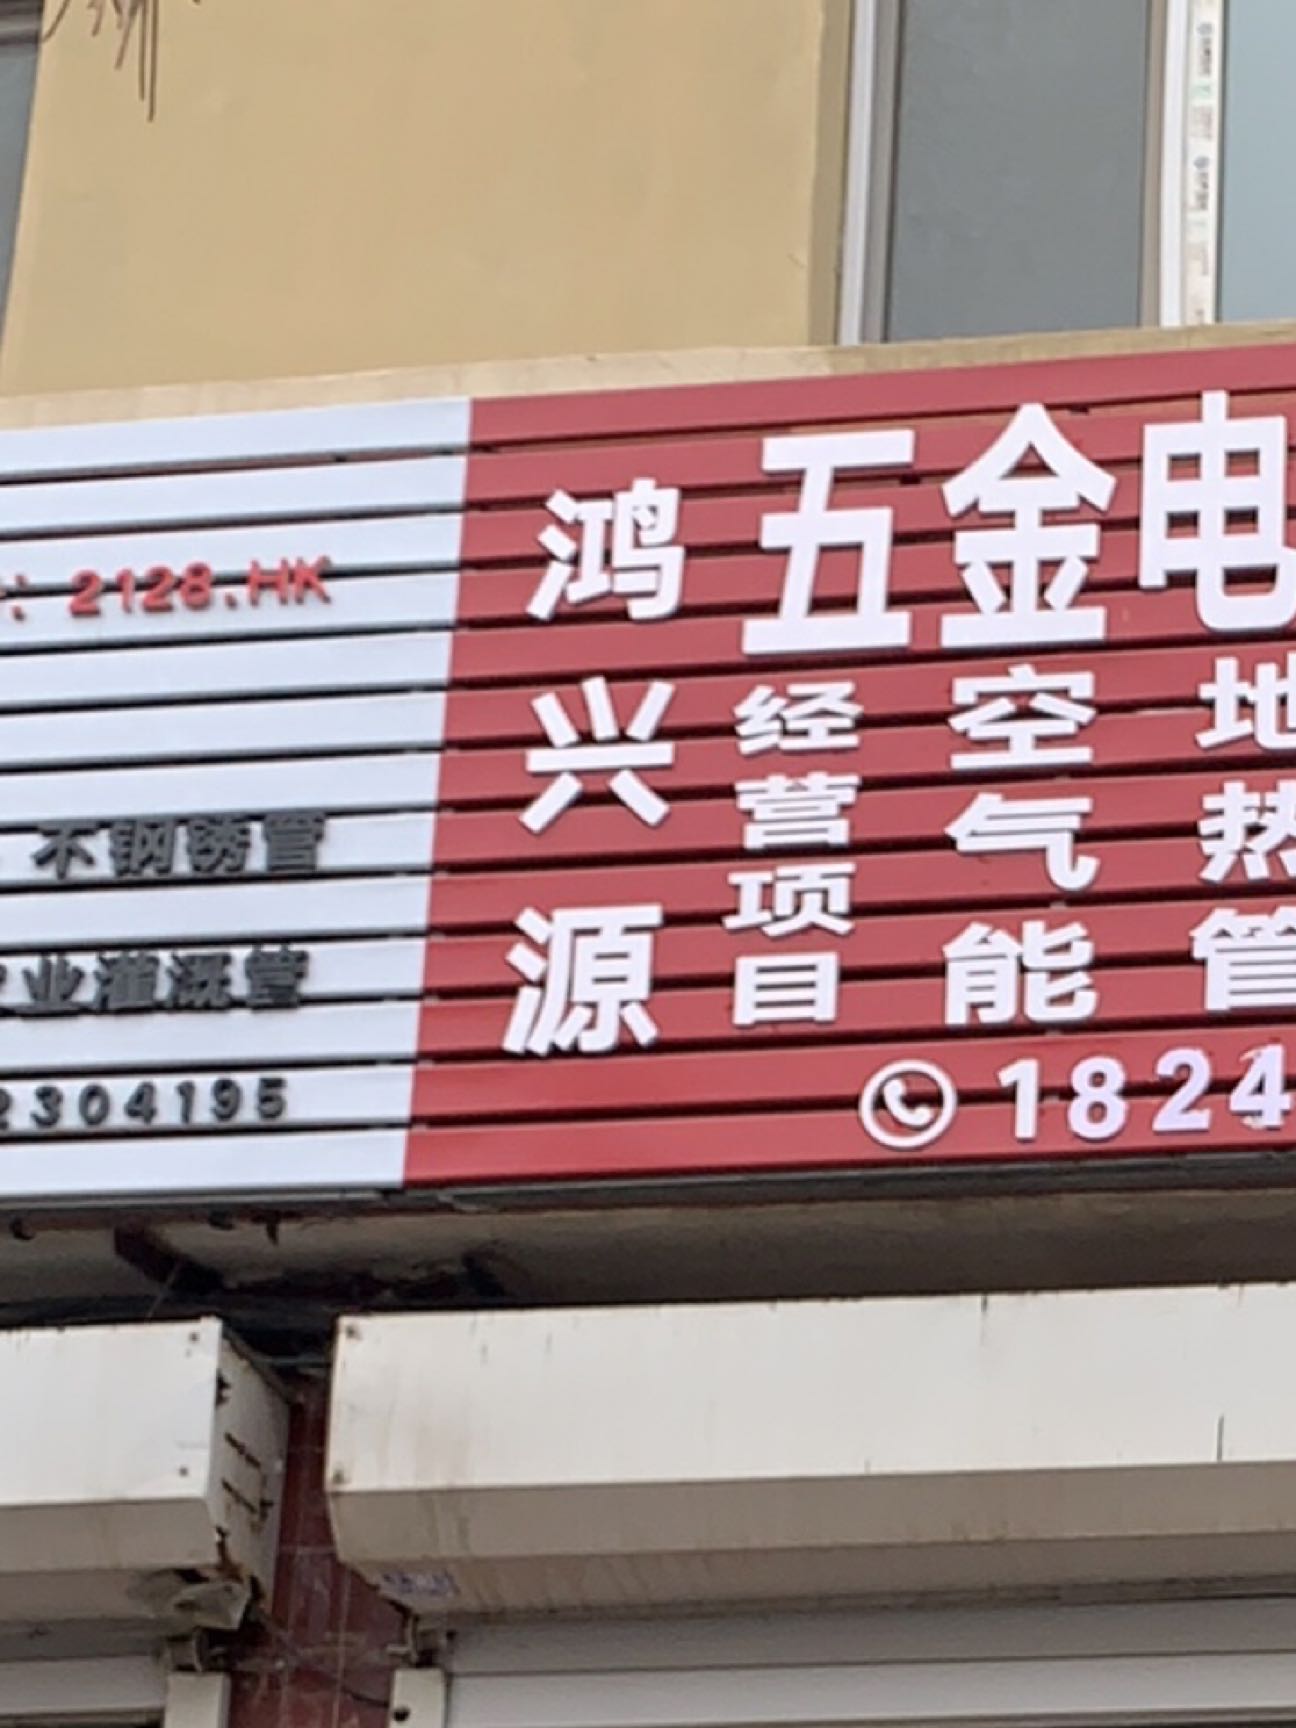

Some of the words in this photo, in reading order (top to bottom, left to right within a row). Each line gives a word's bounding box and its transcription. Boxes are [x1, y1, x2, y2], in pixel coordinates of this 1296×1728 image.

[69, 555, 331, 617] 2128.HK
[502, 478, 685, 1055] 鸿兴源
[723, 681, 863, 1026] 经营项目
[943, 663, 1099, 1026] 空气能
[0, 944, 308, 1016] 业灌溉管
